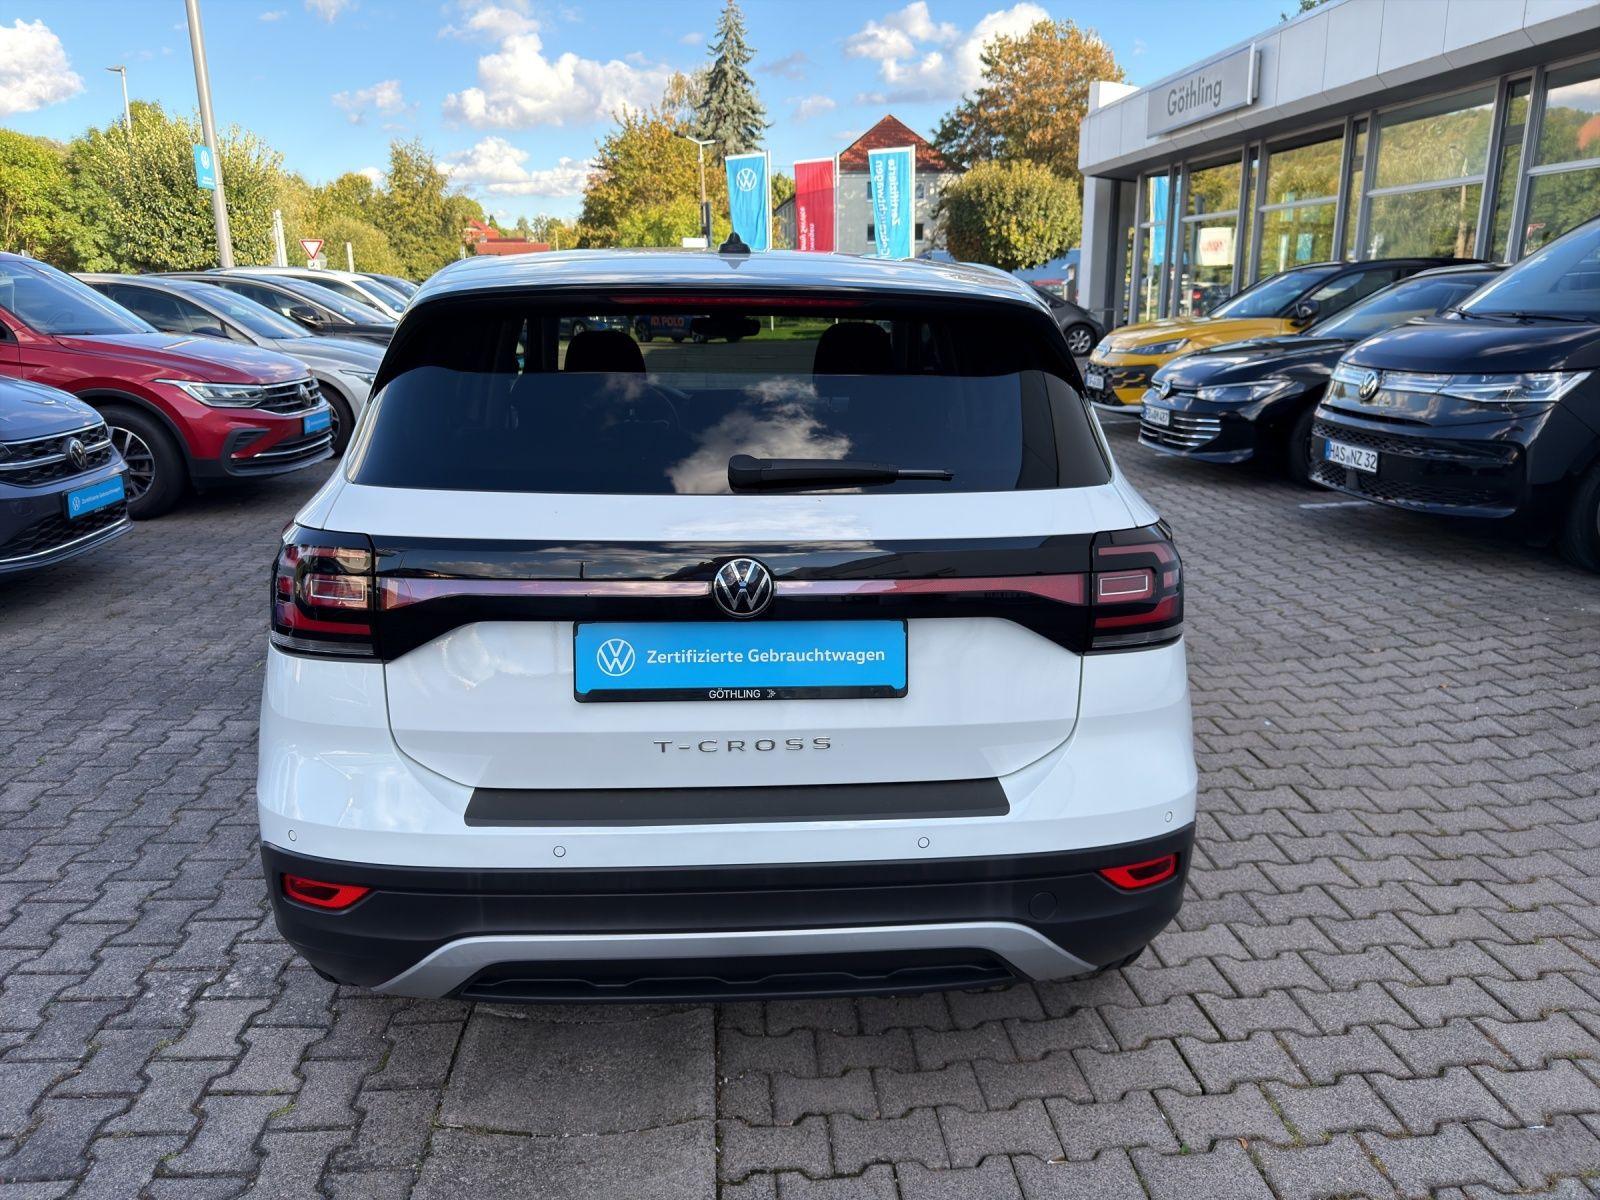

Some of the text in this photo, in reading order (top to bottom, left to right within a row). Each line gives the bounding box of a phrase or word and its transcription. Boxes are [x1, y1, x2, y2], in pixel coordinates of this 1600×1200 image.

[1167, 76, 1222, 116] Göthling
[1330, 443, 1377, 470] HAS NZ 32
[646, 649, 744, 665] Zertifizierte
[747, 648, 886, 665] Gebrauchtwagen
[708, 687, 761, 699] GÖTHLING
[653, 737, 832, 754] T-CROSS
